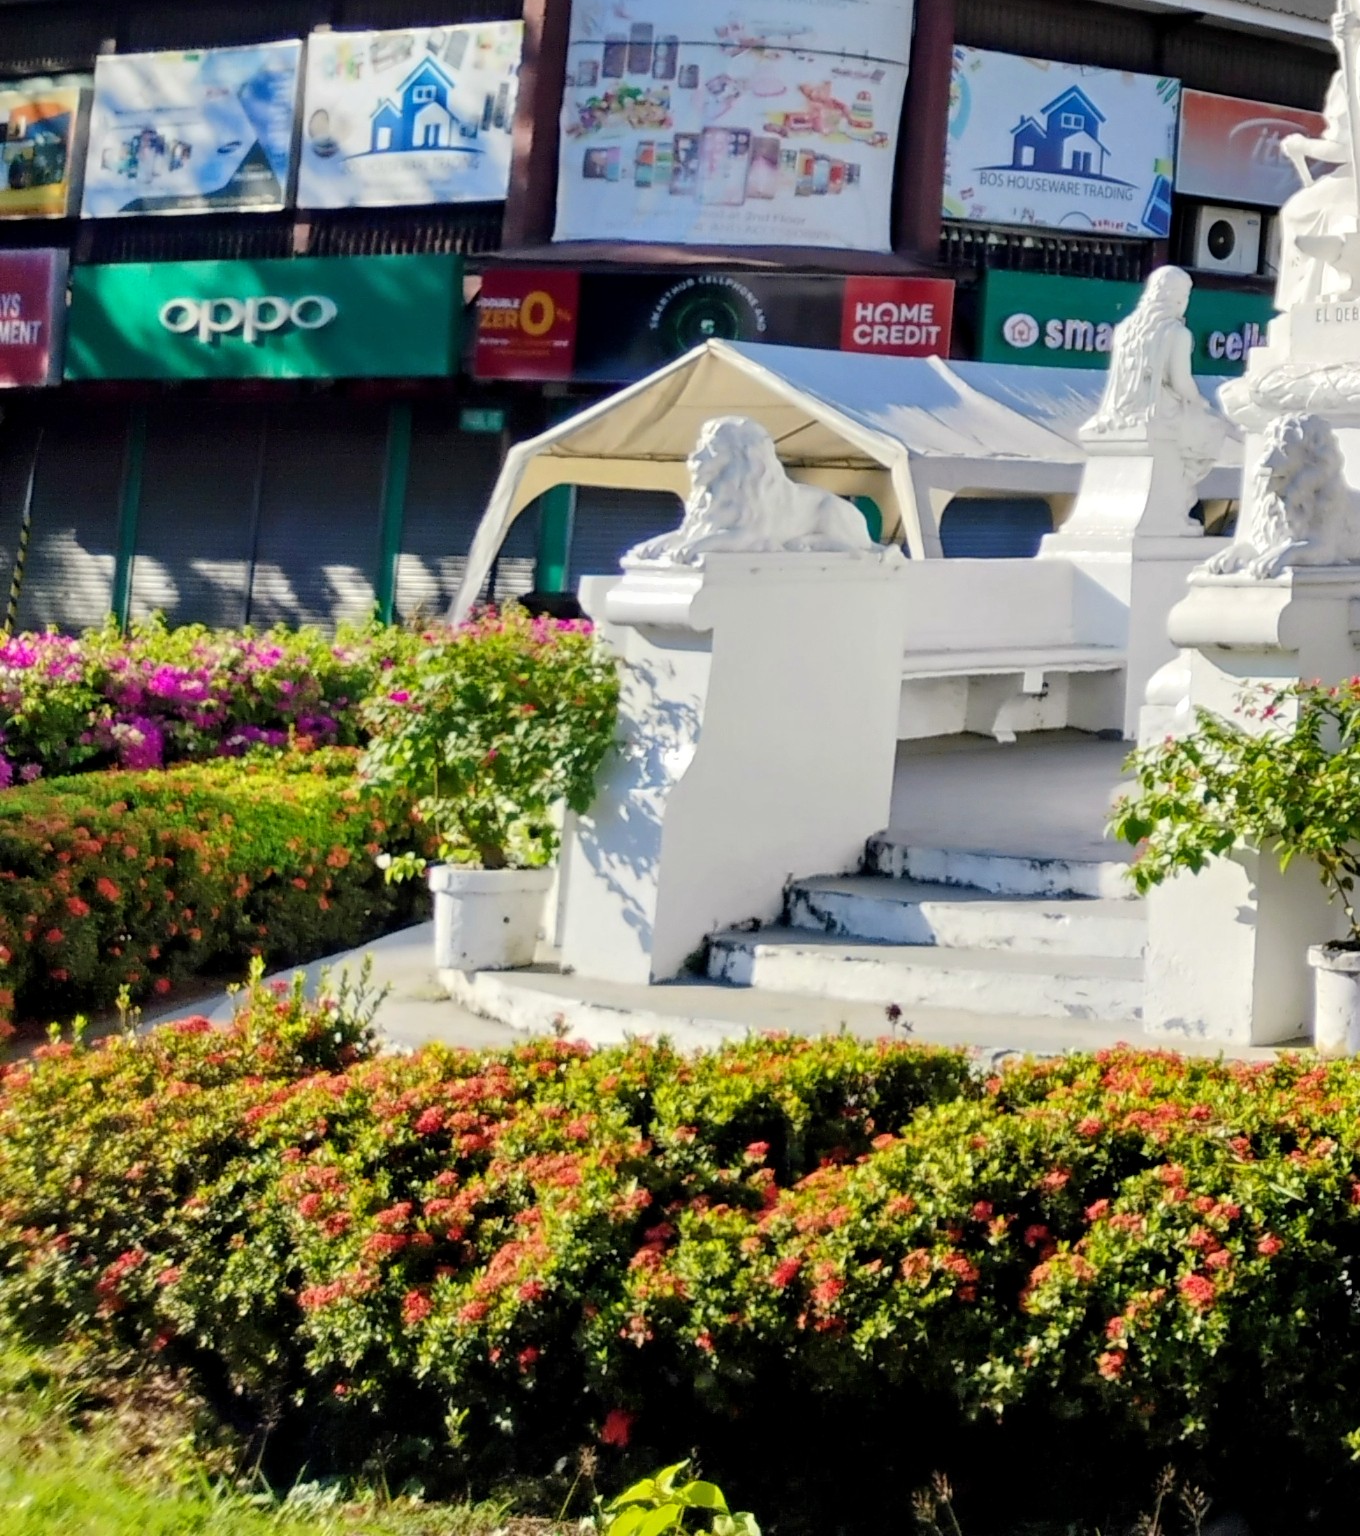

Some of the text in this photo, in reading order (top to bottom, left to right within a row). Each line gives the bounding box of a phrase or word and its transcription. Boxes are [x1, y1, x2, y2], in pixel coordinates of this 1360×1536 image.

[979, 171, 1135, 202] BOS HOUSEWARE TRADING
[855, 302, 934, 323] HOME
[1315, 309, 1331, 322] EL
[853, 325, 942, 345] CREDIT
